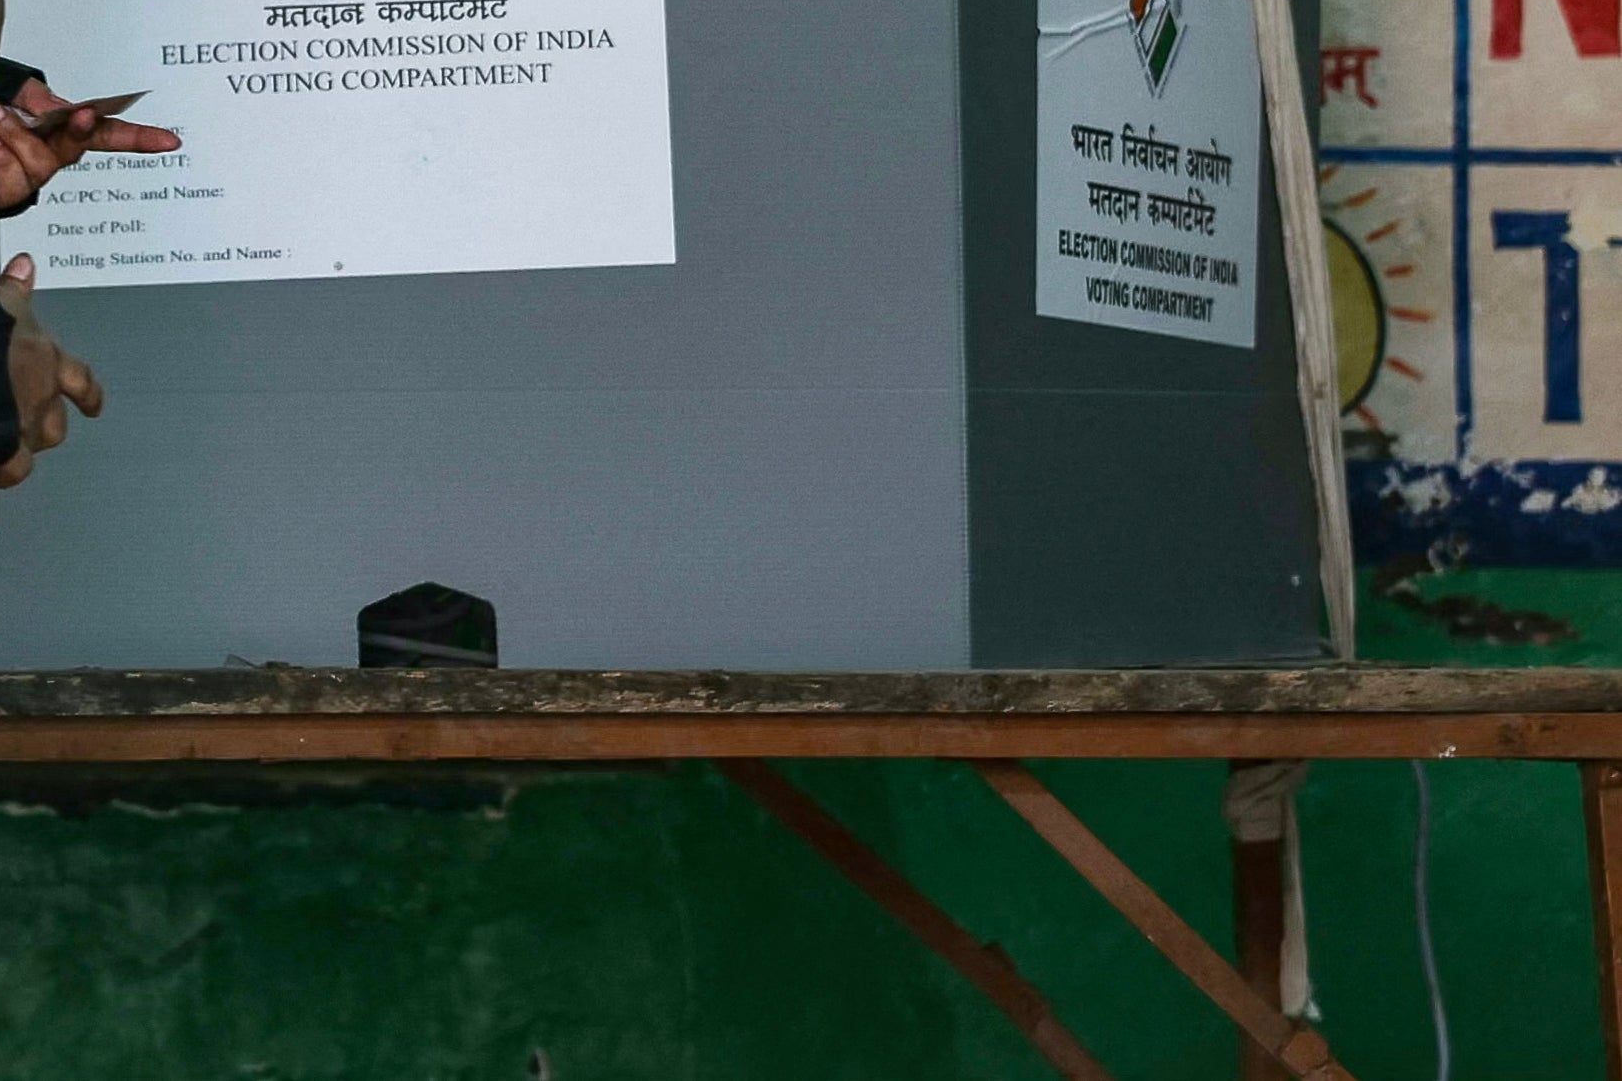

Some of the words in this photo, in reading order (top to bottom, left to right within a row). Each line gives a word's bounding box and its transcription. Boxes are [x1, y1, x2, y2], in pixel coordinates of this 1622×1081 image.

[264, 2, 365, 28] मतदान
[161, 39, 298, 65] ELECTION
[306, 33, 485, 60] COMMISSION
[493, 31, 528, 52] OF
[537, 28, 615, 51] INDIA
[226, 71, 335, 94] VOTING
[341, 62, 553, 91] COMPARTMENT
[95, 156, 114, 170] of
[116, 153, 191, 169] State/UT:
[1070, 124, 1114, 163] भारत
[1121, 122, 1180, 177] निर्वाचन
[1184, 137, 1232, 187] आयोग
[46, 190, 102, 204] AC/PC
[107, 189, 134, 201] No.
[140, 186, 168, 200] and
[173, 186, 225, 199] Name:
[1087, 181, 1141, 224] मतदान
[47, 223, 84, 236] Date
[88, 221, 107, 234] of
[110, 220, 146, 233] Poll:
[49, 253, 105, 269] Polling
[110, 251, 165, 265] Station
[169, 250, 197, 262] No.
[203, 248, 230, 261] and
[235, 246, 282, 260] Name
[1058, 229, 1119, 264] ELECTION
[1120, 241, 1192, 278] COMMISSION
[1192, 255, 1209, 282] OF
[1210, 258, 1239, 286] INDIA
[1086, 276, 1130, 308] VOTING
[1132, 284, 1214, 322] COMPARTMENT
